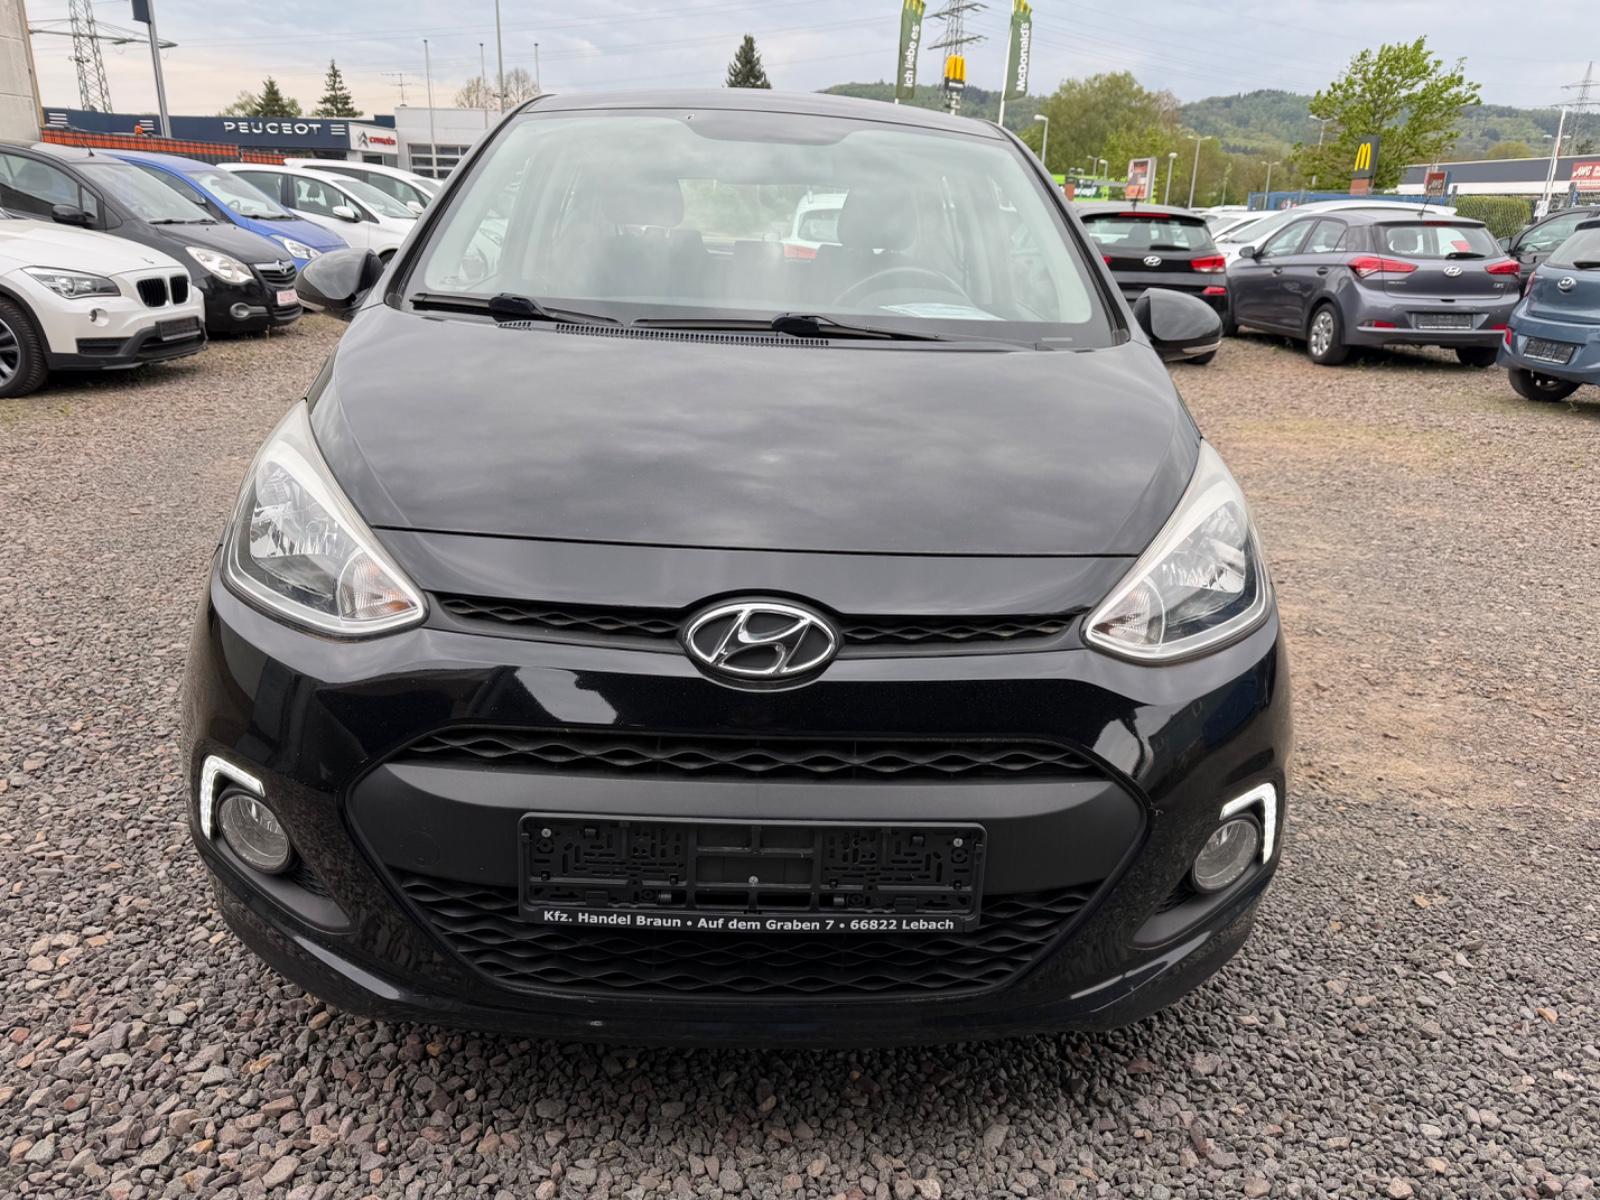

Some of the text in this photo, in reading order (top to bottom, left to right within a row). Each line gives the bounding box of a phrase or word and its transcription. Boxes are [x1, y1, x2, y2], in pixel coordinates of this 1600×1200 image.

[224, 121, 322, 135] PEUGEOT
[543, 910, 954, 931] Kfz. Handel Braun Auf dem Graben 7 66822 Lebach
